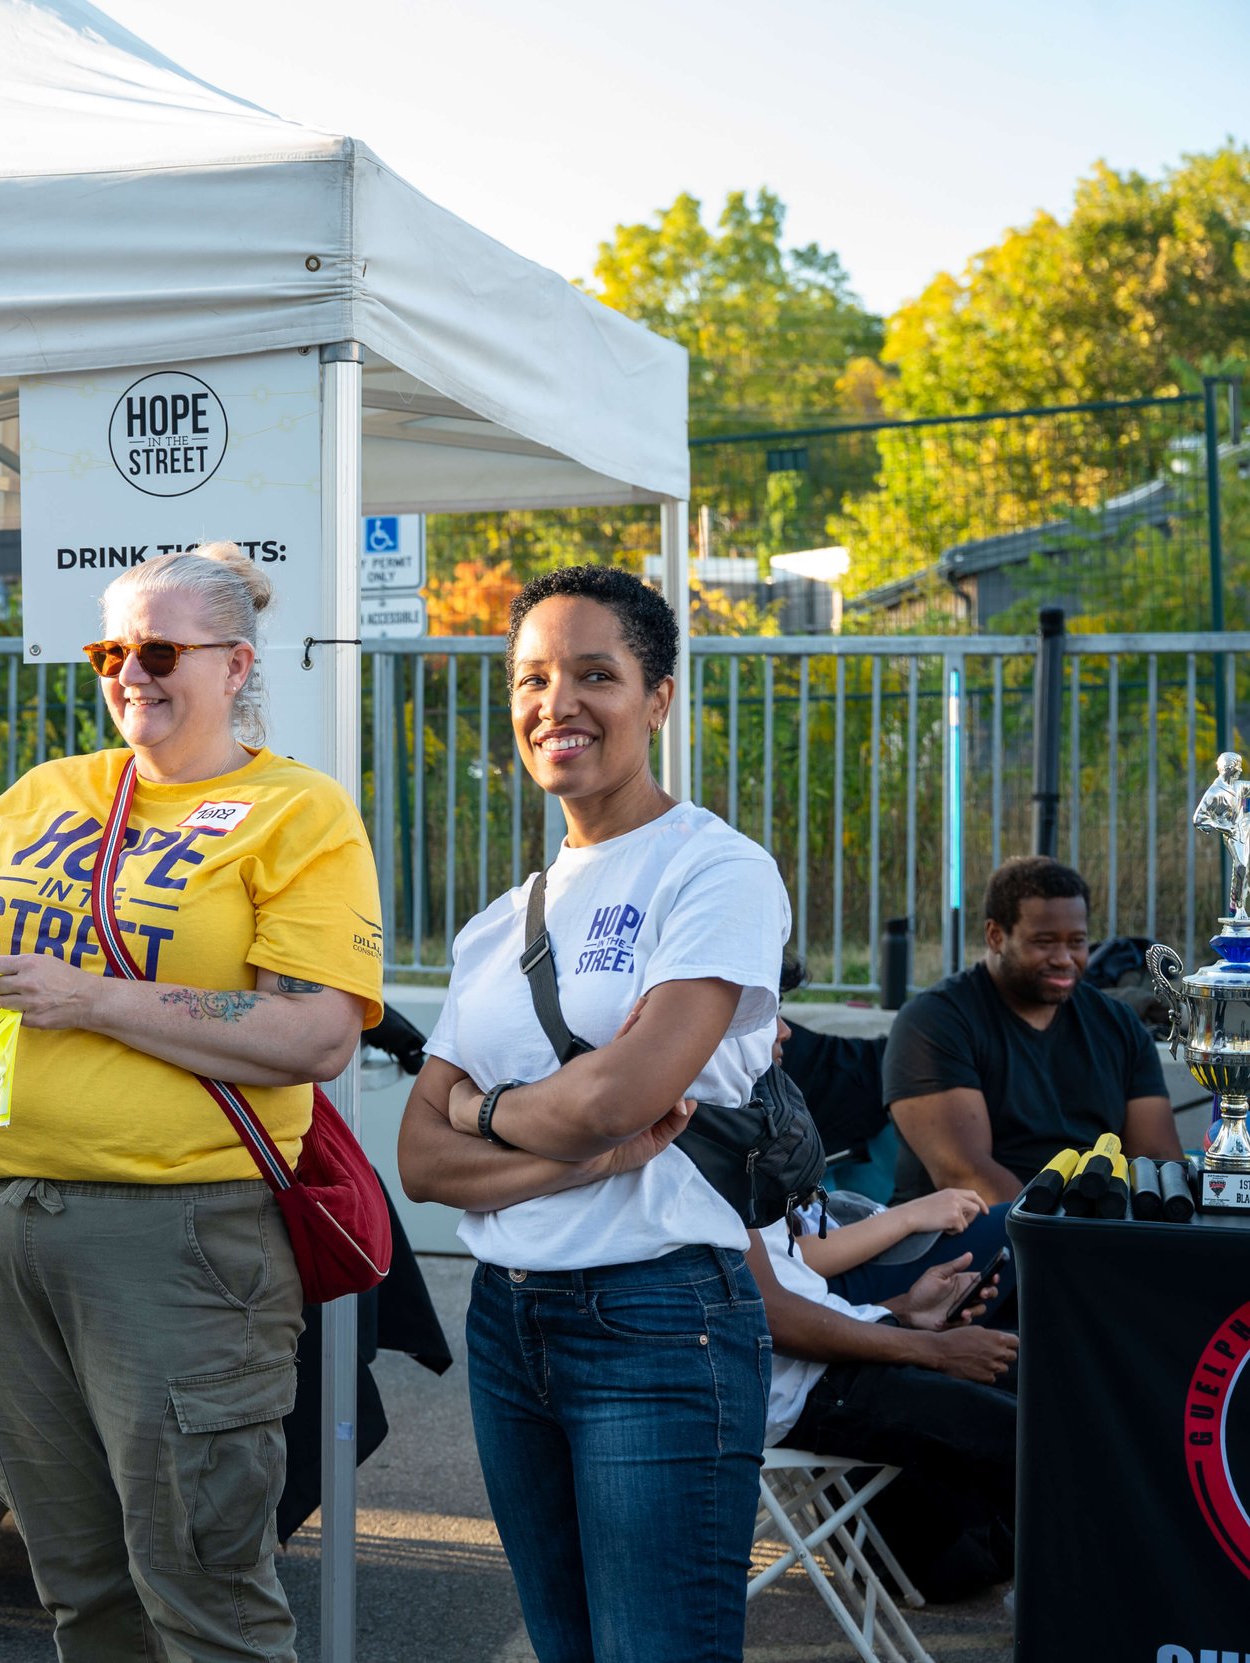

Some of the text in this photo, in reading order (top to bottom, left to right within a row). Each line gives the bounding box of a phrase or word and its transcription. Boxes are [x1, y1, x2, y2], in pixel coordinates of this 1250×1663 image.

[127, 393, 209, 437] HOPE
[148, 436, 189, 447] IN THE
[129, 446, 208, 475] STREET
[57, 545, 149, 569] DRINK
[371, 556, 412, 569] PERMIT
[367, 571, 395, 583] ONLY
[368, 609, 419, 625] ACCESSIBLE
[11, 811, 228, 891] HOPE
[38, 877, 127, 910] IN TE
[596, 936, 627, 949] IN THE
[1189, 1318, 1250, 1446] GUELPH
